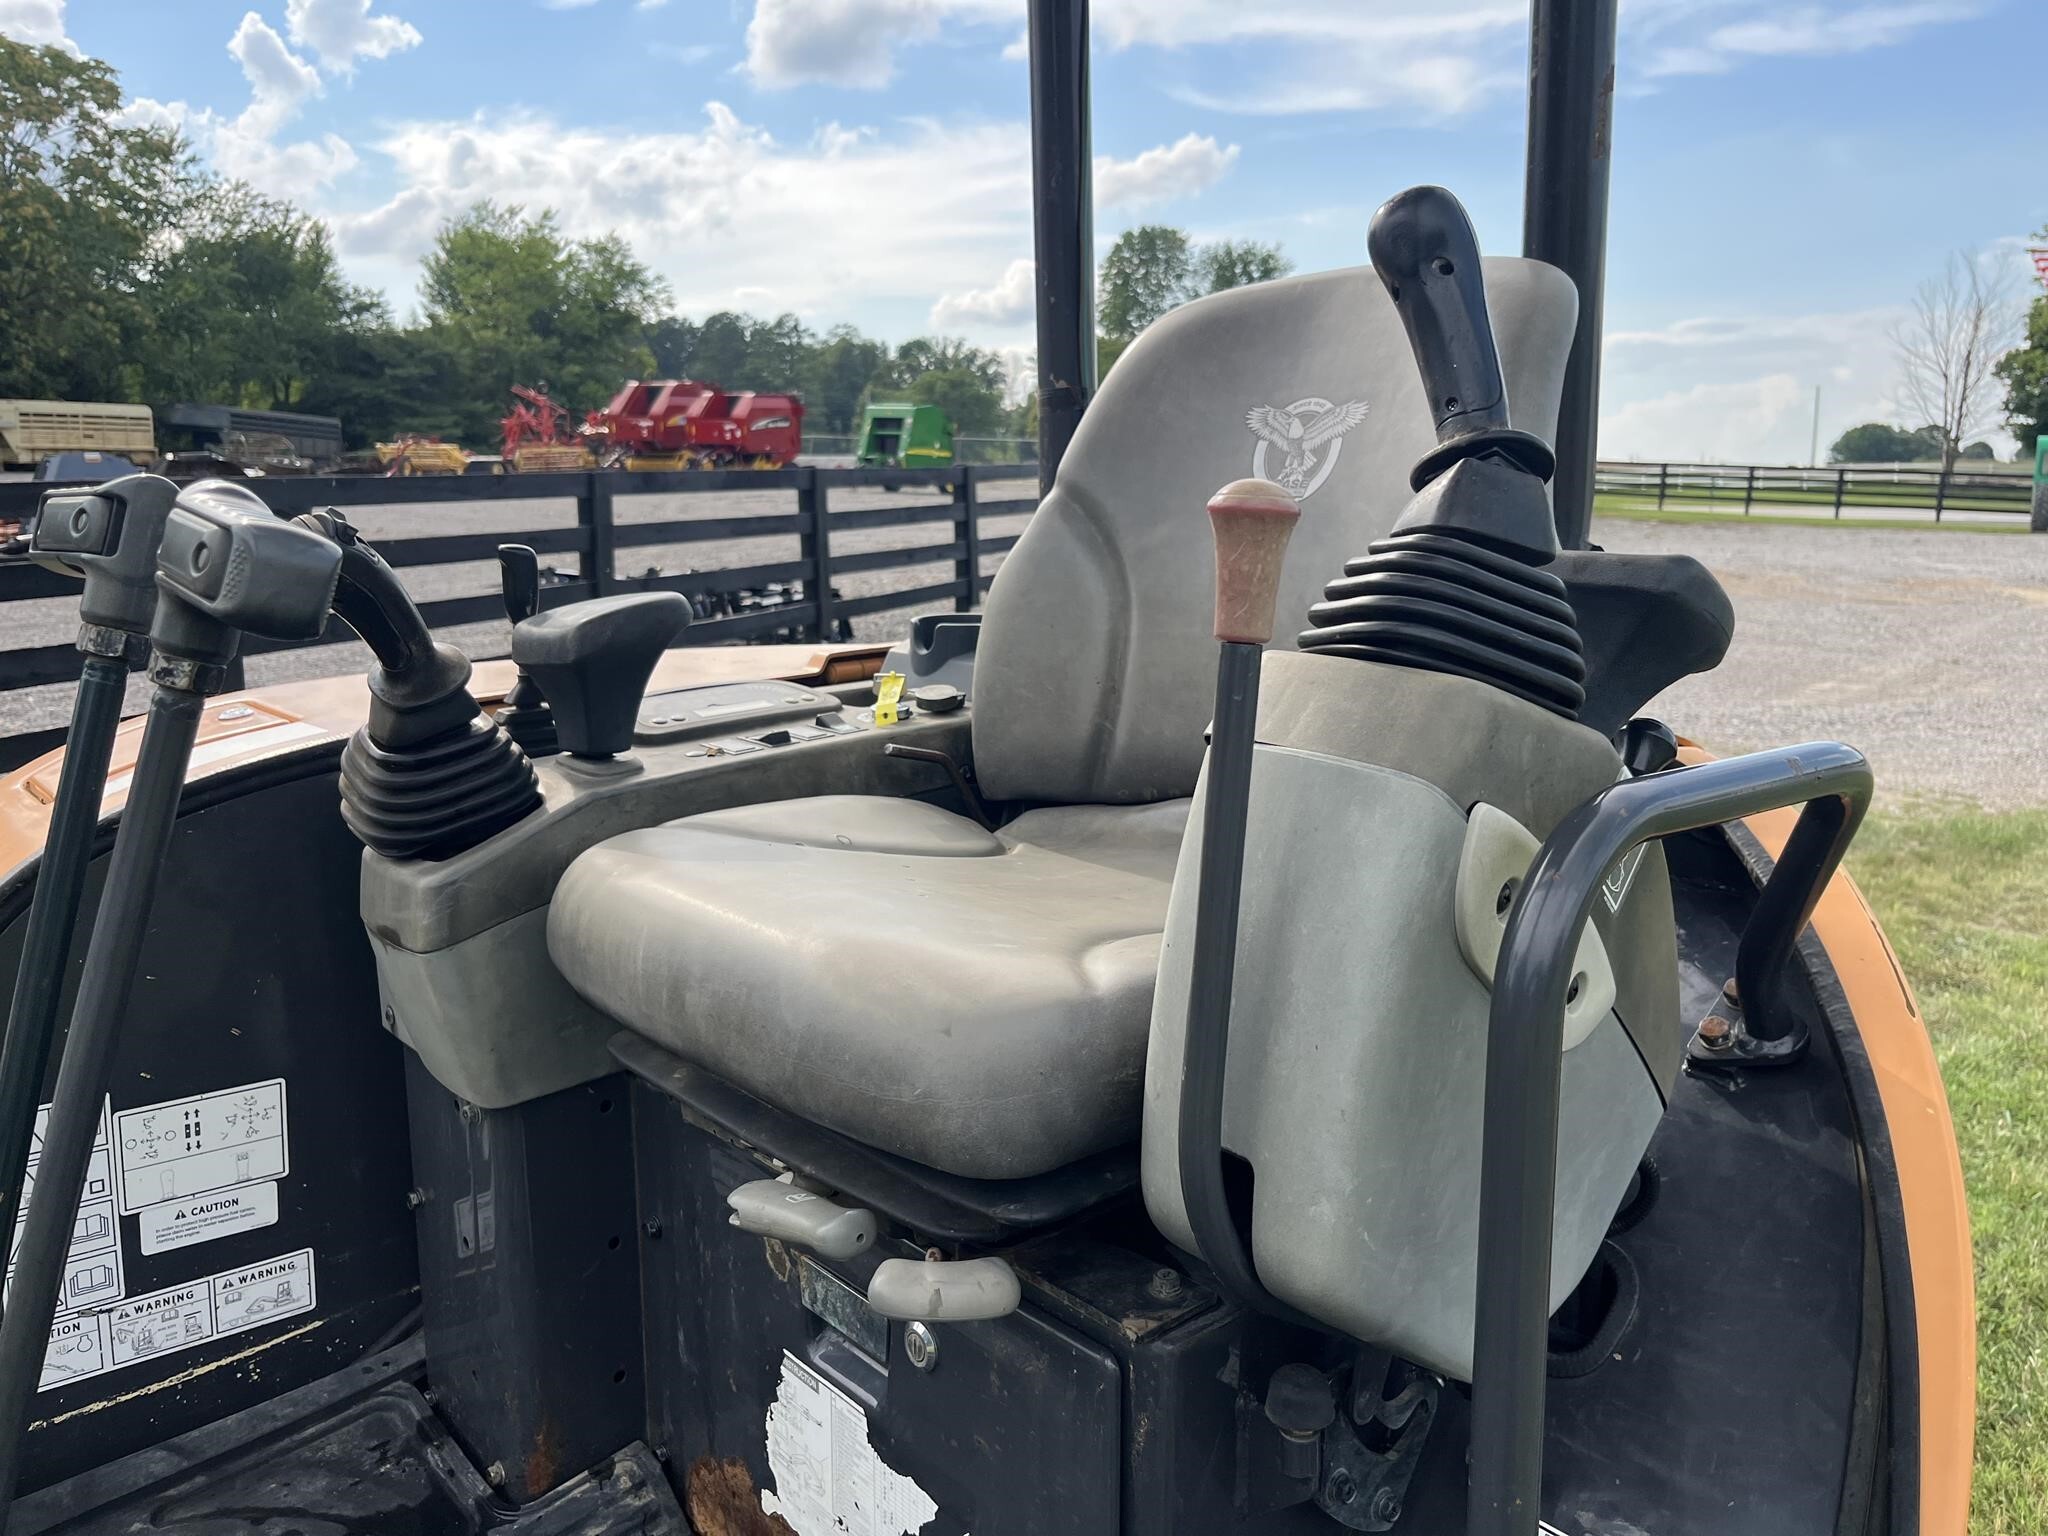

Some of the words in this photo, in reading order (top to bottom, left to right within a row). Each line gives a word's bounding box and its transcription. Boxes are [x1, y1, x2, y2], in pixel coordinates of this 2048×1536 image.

[191, 1198, 239, 1216] CAUTION
[238, 1261, 296, 1285] WARNING
[134, 1290, 194, 1315] WARNING
[50, 1322, 81, 1339] TION
